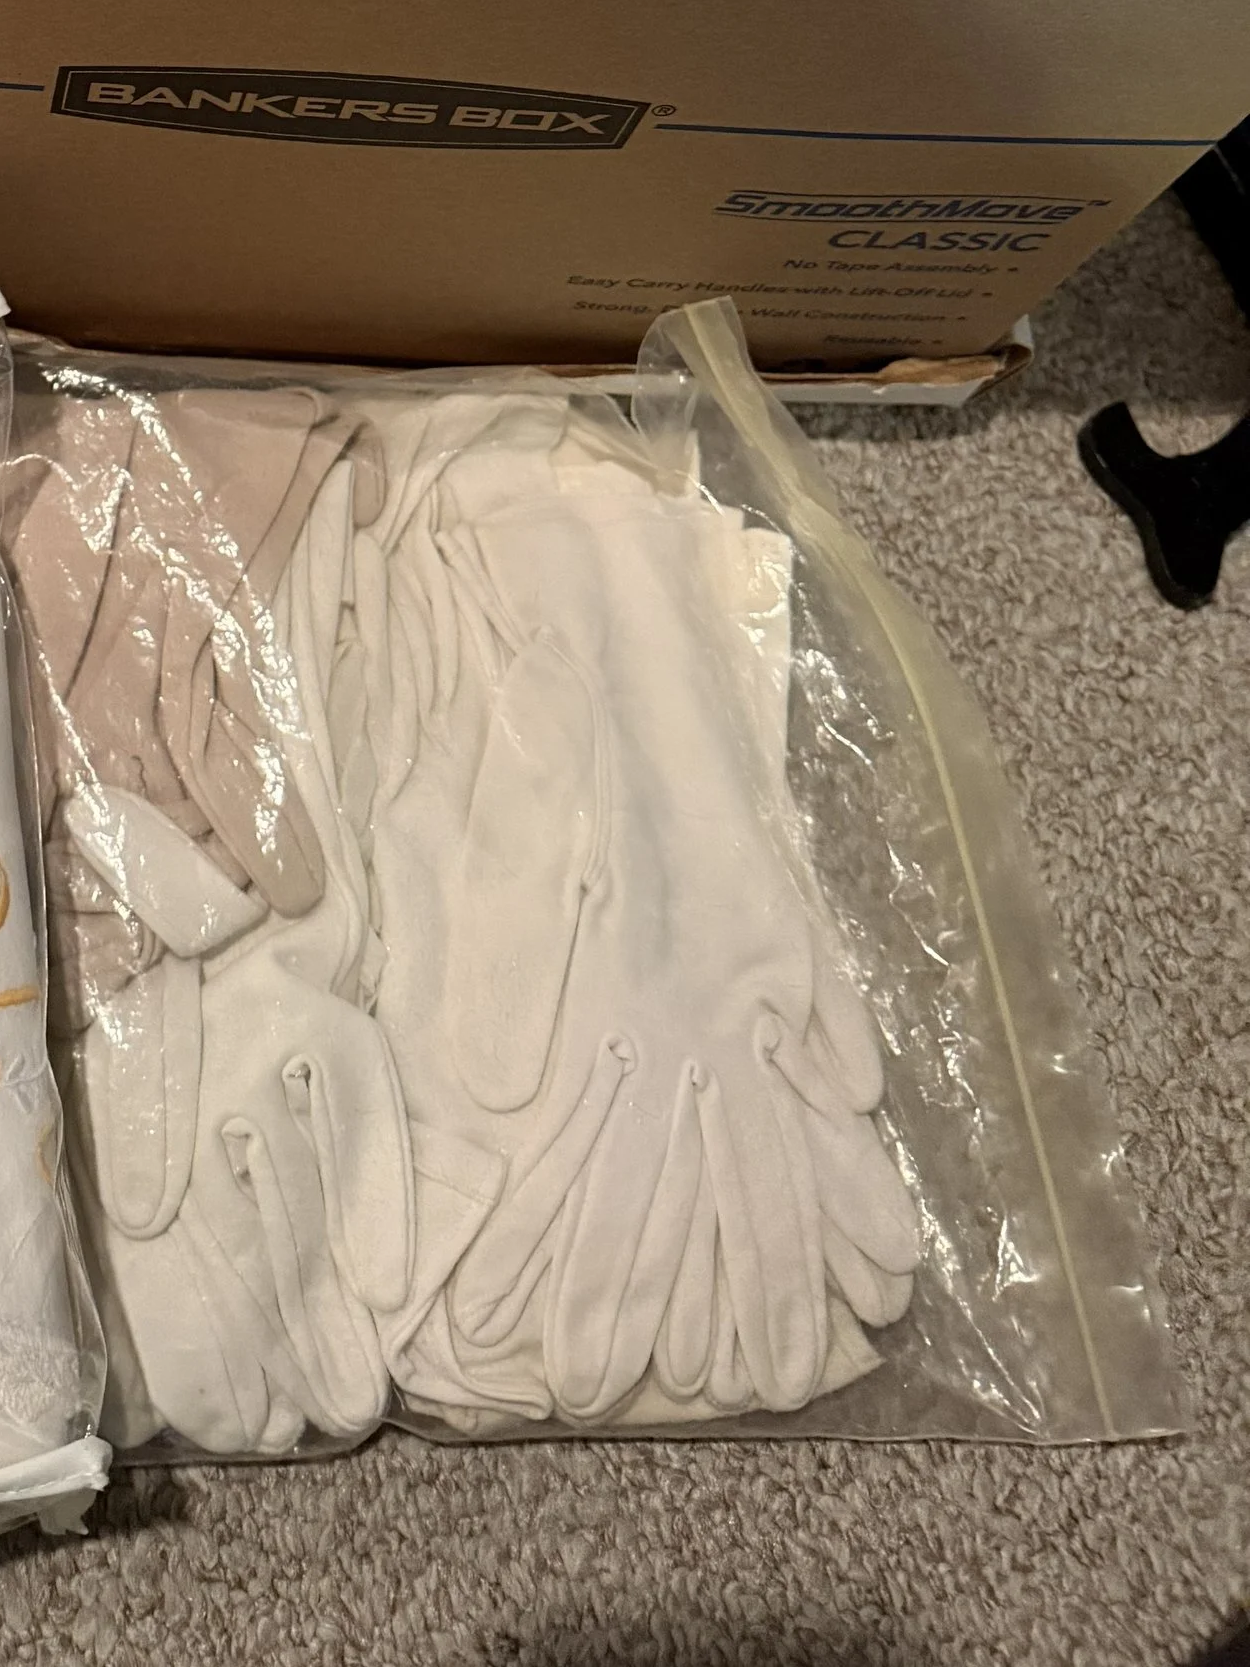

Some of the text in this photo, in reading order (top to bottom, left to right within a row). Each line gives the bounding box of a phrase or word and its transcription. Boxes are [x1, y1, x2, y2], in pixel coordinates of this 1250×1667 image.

[86, 81, 614, 135] BANKERS BOX
[827, 229, 1052, 253] CLASSIC
[782, 258, 998, 275] No Tape Assembly
[566, 275, 622, 289] Easy
[625, 278, 689, 292] Carry
[693, 281, 789, 294] Handles
[794, 286, 843, 296] with
[750, 307, 801, 319] Wall
